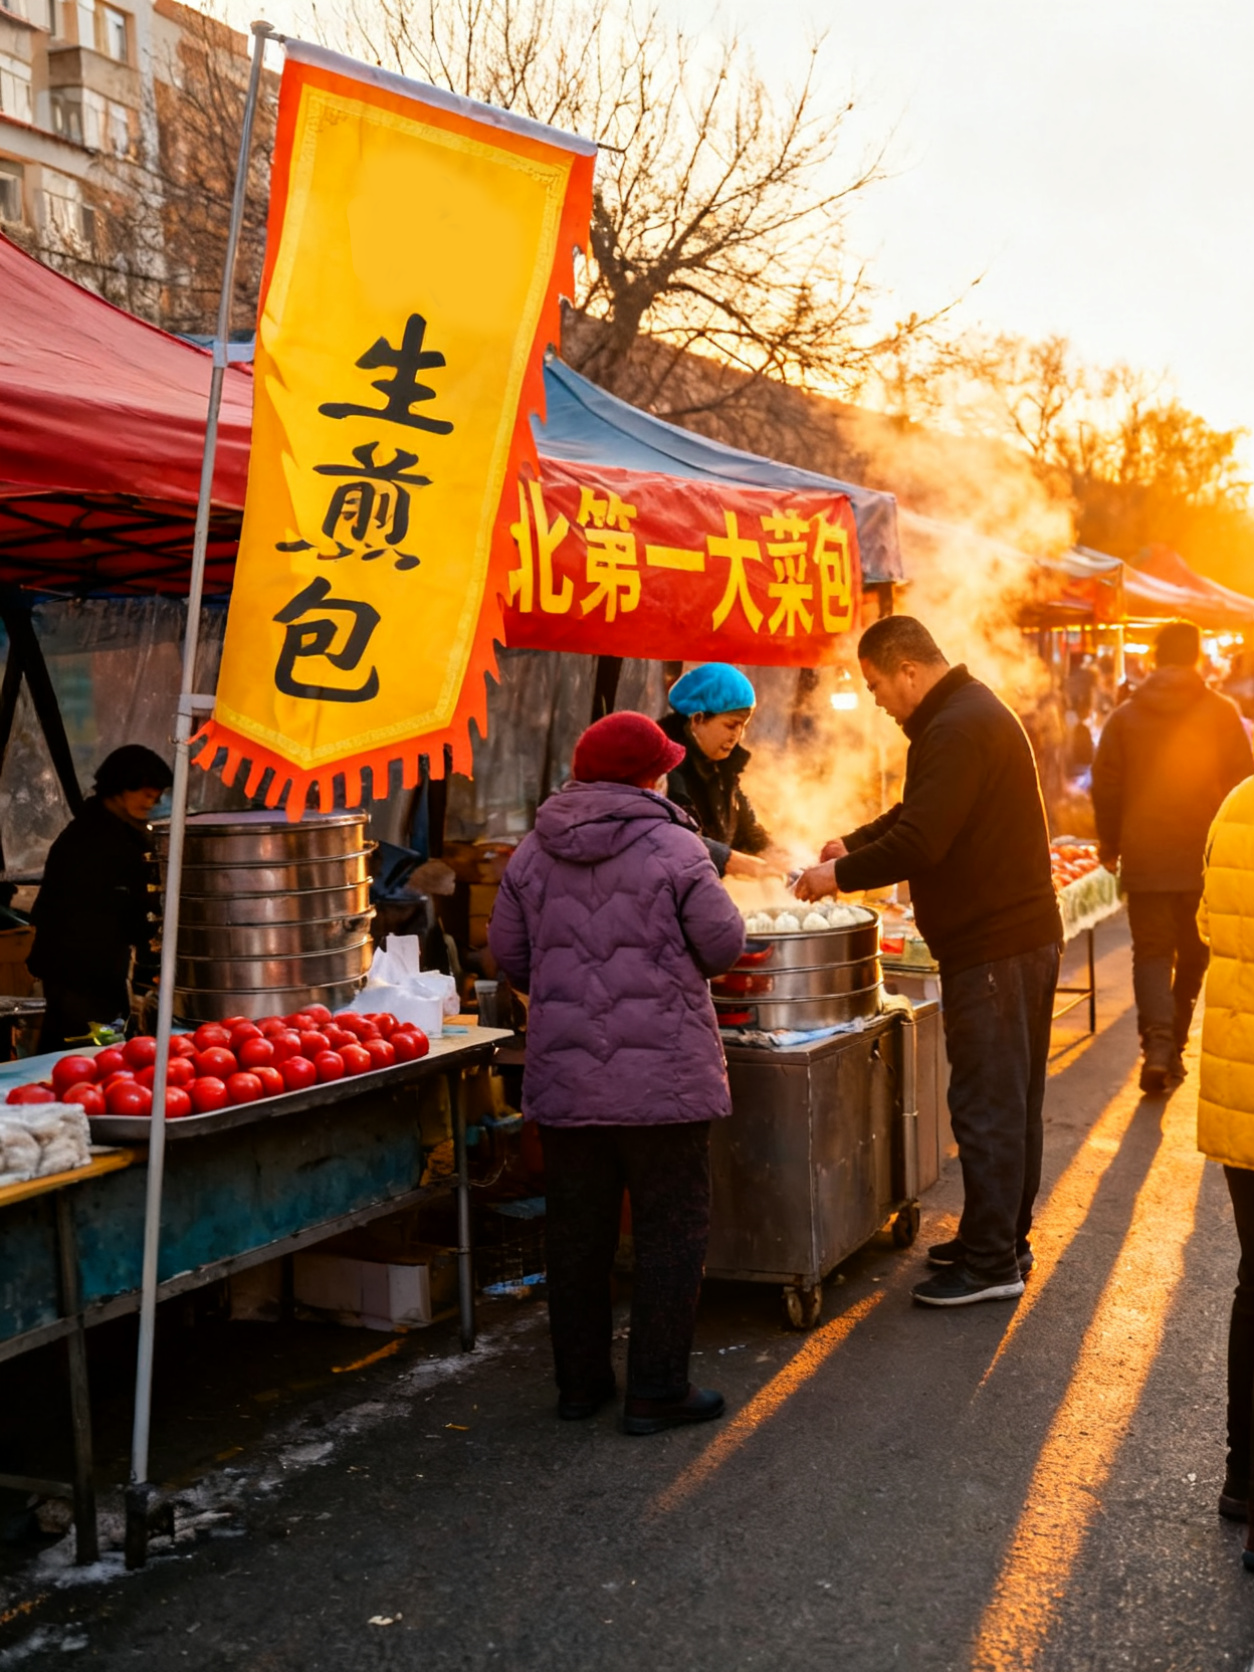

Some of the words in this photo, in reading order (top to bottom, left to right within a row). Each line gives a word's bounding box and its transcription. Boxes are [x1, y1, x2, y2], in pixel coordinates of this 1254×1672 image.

[272, 313, 454, 702] 生煎包
[507, 479, 854, 637] 北第一大菜包
